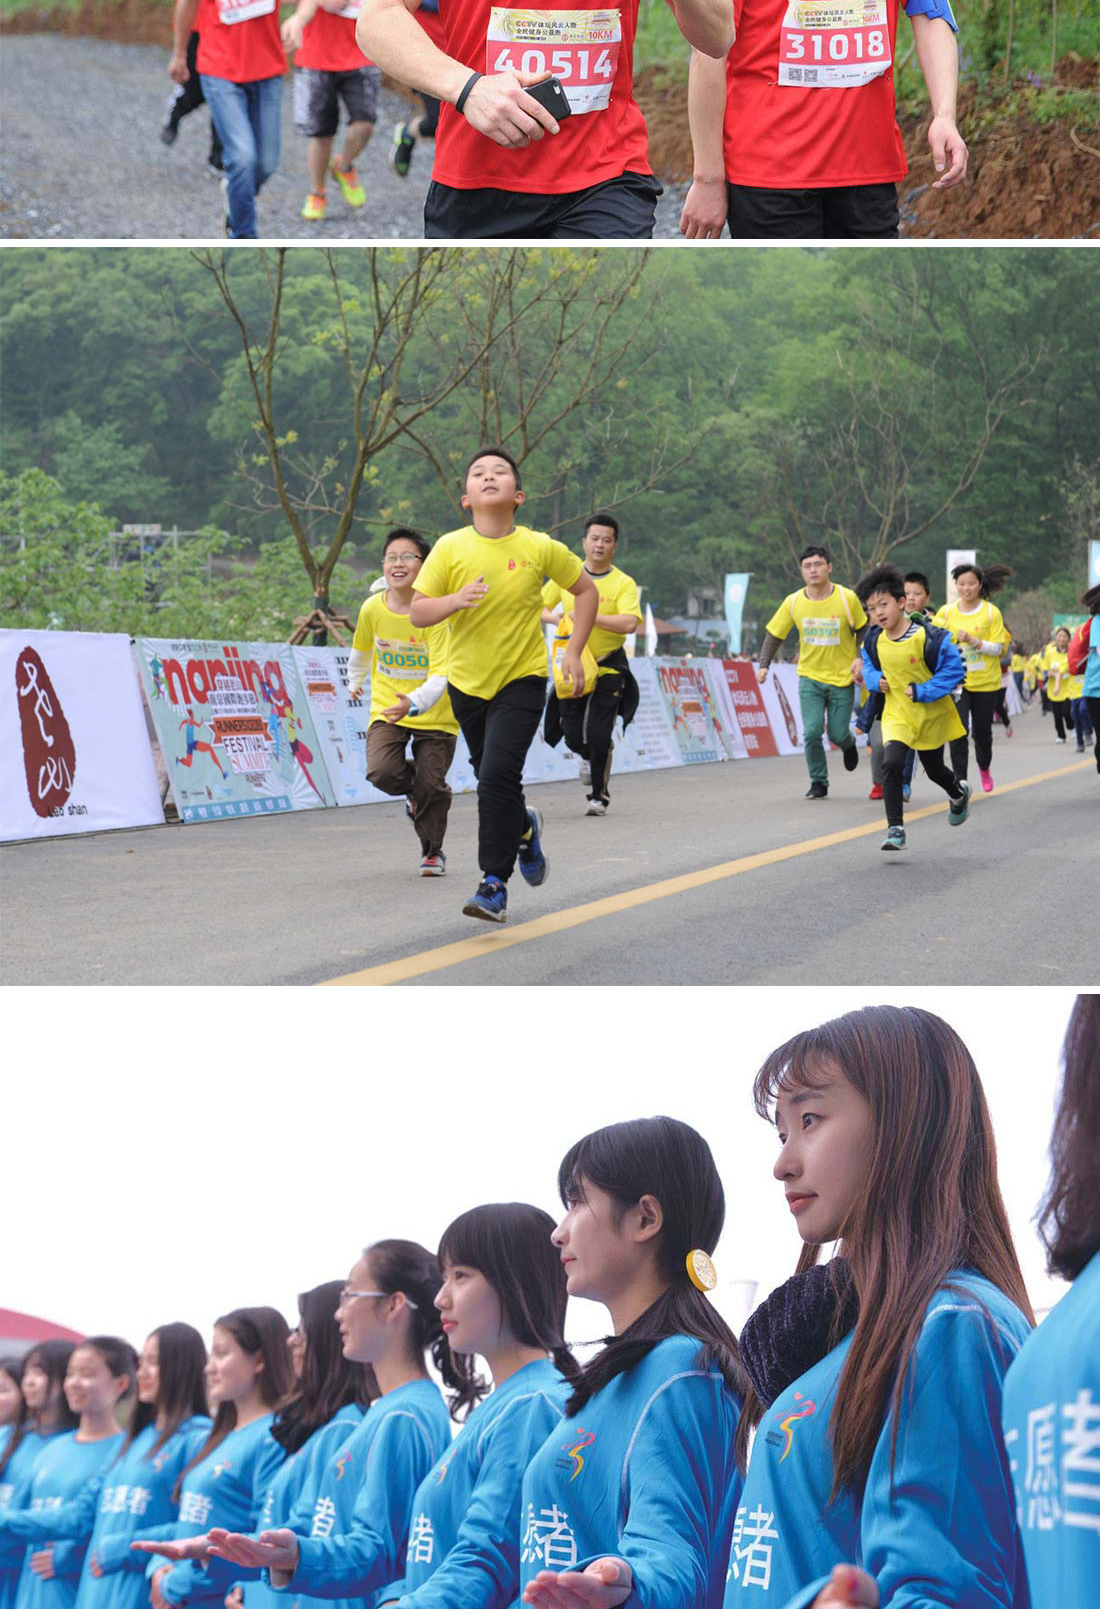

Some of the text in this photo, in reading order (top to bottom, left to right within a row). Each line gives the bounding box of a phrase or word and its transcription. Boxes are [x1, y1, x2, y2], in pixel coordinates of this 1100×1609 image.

[588, 30, 613, 40] 10KM
[786, 30, 884, 60] 31018
[494, 48, 612, 79] 40514
[161, 646, 293, 718] nanjing
[223, 737, 268, 753] FESTIVAL
[68, 803, 88, 816] shan
